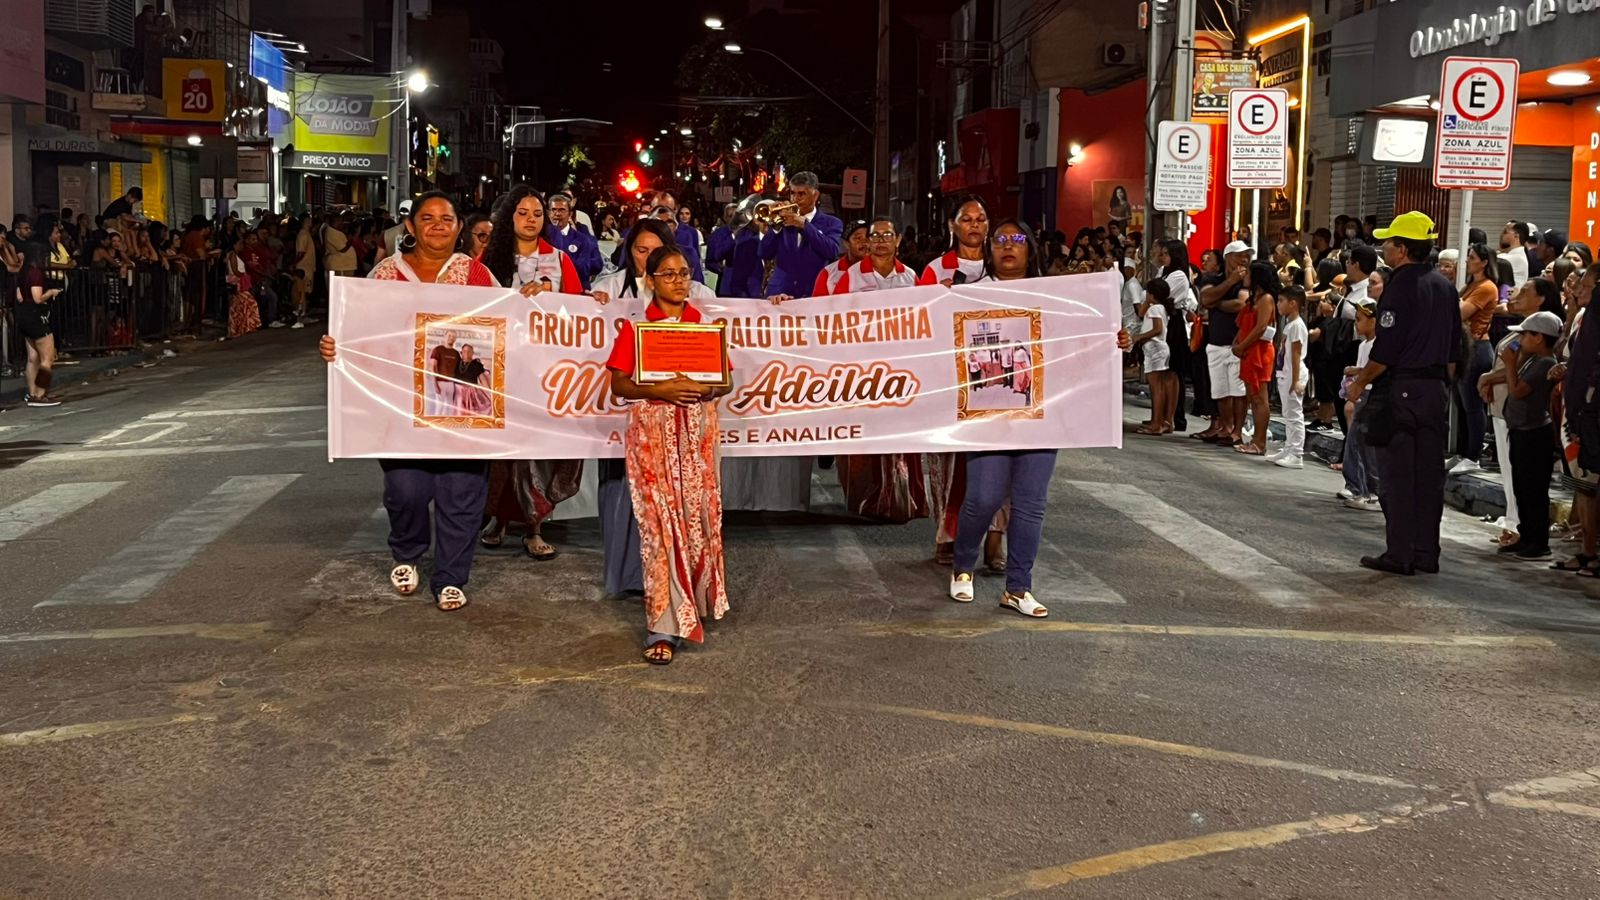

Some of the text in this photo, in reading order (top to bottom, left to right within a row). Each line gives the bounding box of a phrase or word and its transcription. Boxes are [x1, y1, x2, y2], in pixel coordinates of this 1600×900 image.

[1409, 6, 1518, 58] Odontologia
[1526, 0, 1557, 26] de
[183, 92, 208, 109] 20
[1469, 81, 1487, 108] E
[304, 97, 362, 114] LOJÃO
[1251, 104, 1264, 124] E
[331, 120, 370, 131] MODA
[28, 139, 96, 151] MOLDURAS
[1178, 135, 1190, 153] E
[1445, 139, 1502, 148] ZONA AZUL
[302, 155, 371, 167] PREÇO ÚNICO
[852, 175, 859, 184] E
[529, 310, 605, 349] GRUPO
[780, 314, 808, 347] DE
[815, 306, 932, 345] VARZINHA
[732, 363, 914, 409] Adeilda
[747, 428, 759, 443] E
[766, 425, 862, 443] ANALICE
